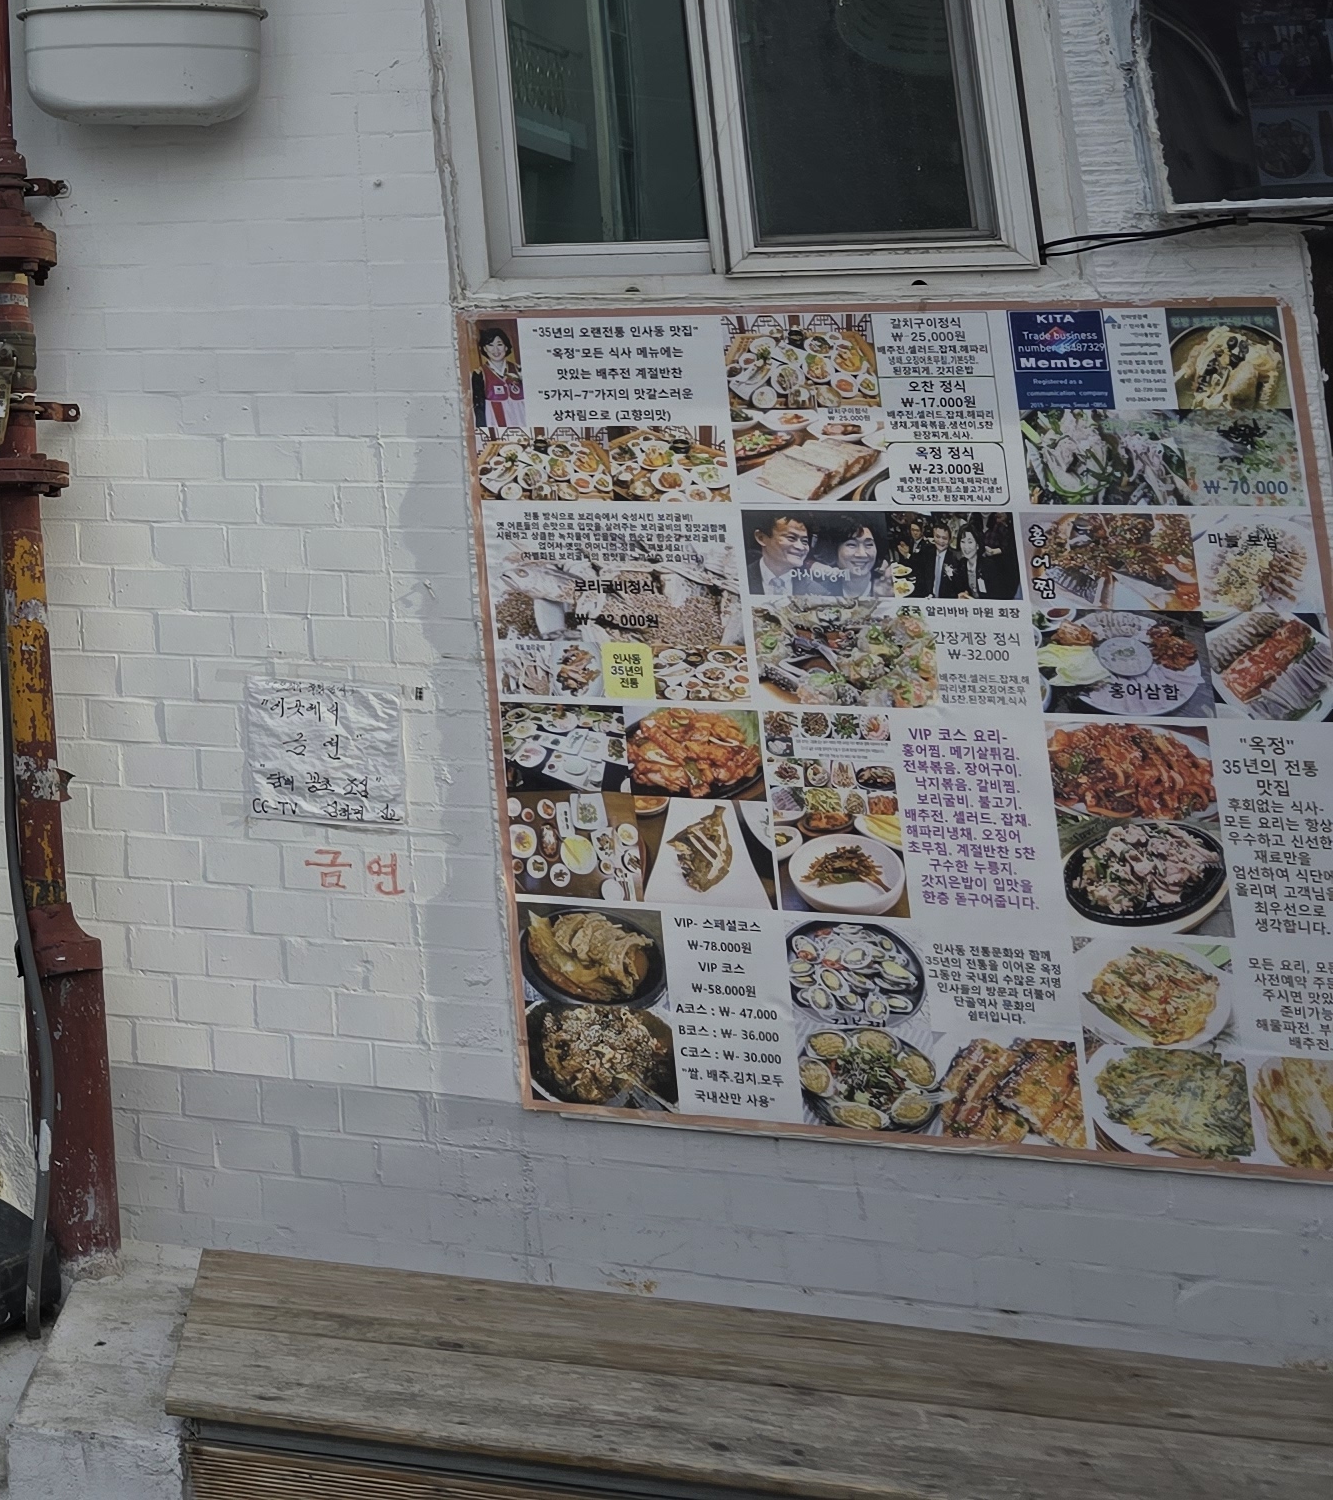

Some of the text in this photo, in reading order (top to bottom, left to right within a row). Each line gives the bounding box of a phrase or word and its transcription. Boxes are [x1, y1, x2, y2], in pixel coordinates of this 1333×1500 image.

[890, 317, 961, 328] 갈치구이정식
[1036, 315, 1074, 323] KITA
[630, 326, 665, 337] 인사동
[670, 325, 698, 337] 맛집"
[1022, 331, 1097, 340] Trade business
[609, 347, 631, 358] 식사
[637, 347, 683, 358] 메뉴에는
[1020, 358, 1103, 368] Member
[557, 368, 682, 380] 맛있는 배추전 계절반찬
[908, 380, 966, 393] 오찬 정식
[553, 410, 611, 422] 상차림으로
[916, 447, 974, 460] 옥정 정식
[1207, 532, 1240, 548] 마늘
[926, 606, 969, 617] 알리바바
[973, 608, 994, 618] 마윈
[998, 608, 1020, 618] 회장
[933, 631, 1020, 646] 간장게장 정식
[613, 654, 641, 665] 인사동
[611, 666, 643, 676] 35년의
[620, 678, 639, 689] 전통
[1109, 682, 1181, 701] 홍어삼합
[908, 728, 932, 741] VIP
[938, 728, 967, 742] 코스
[1239, 736, 1294, 755] "옥정"
[1222, 758, 1319, 777] 35년의 전통
[305, 772, 335, 792] 꽁초
[1256, 778, 1290, 797] 맛집
[253, 798, 298, 815] CC-TV
[1228, 798, 1284, 814] 후회없는
[1224, 815, 1333, 833] 모든 요리는 항상
[982, 828, 1021, 843] 오징어
[1228, 831, 1332, 850] 우수하고 신선한
[957, 843, 1009, 859] 계절반찬
[1015, 847, 1035, 860] 5찬
[1254, 850, 1312, 866] 재료만을
[304, 849, 405, 895] 금연
[929, 859, 968, 873] 구수한
[1233, 865, 1289, 882] 엄선하여
[921, 874, 1033, 893] 갓지은밥이 입맛을
[1255, 901, 1326, 918] 최우선으로
[702, 918, 761, 933] 스페셜코스
[933, 943, 965, 956] 인사동
[969, 945, 1025, 959] 전통문화와
[698, 961, 745, 974] VIP 코스
[925, 955, 1061, 976] 35년의 전통을 이어온 옥정
[1248, 957, 1274, 971] 모든
[929, 968, 1061, 988] 그동안 국내외 수많은 저명
[1254, 973, 1307, 989] 사전예약
[937, 982, 1056, 1001] 인사들의 방문과 더불어
[1263, 989, 1303, 1003] 주시면
[676, 1003, 778, 1021] A코스 47.000
[1002, 1000, 1035, 1012] 문화의
[678, 1025, 779, 1043] B코스 36.000
[681, 1047, 782, 1065] C코스 30.000
[694, 1089, 741, 1106] 국내산만
